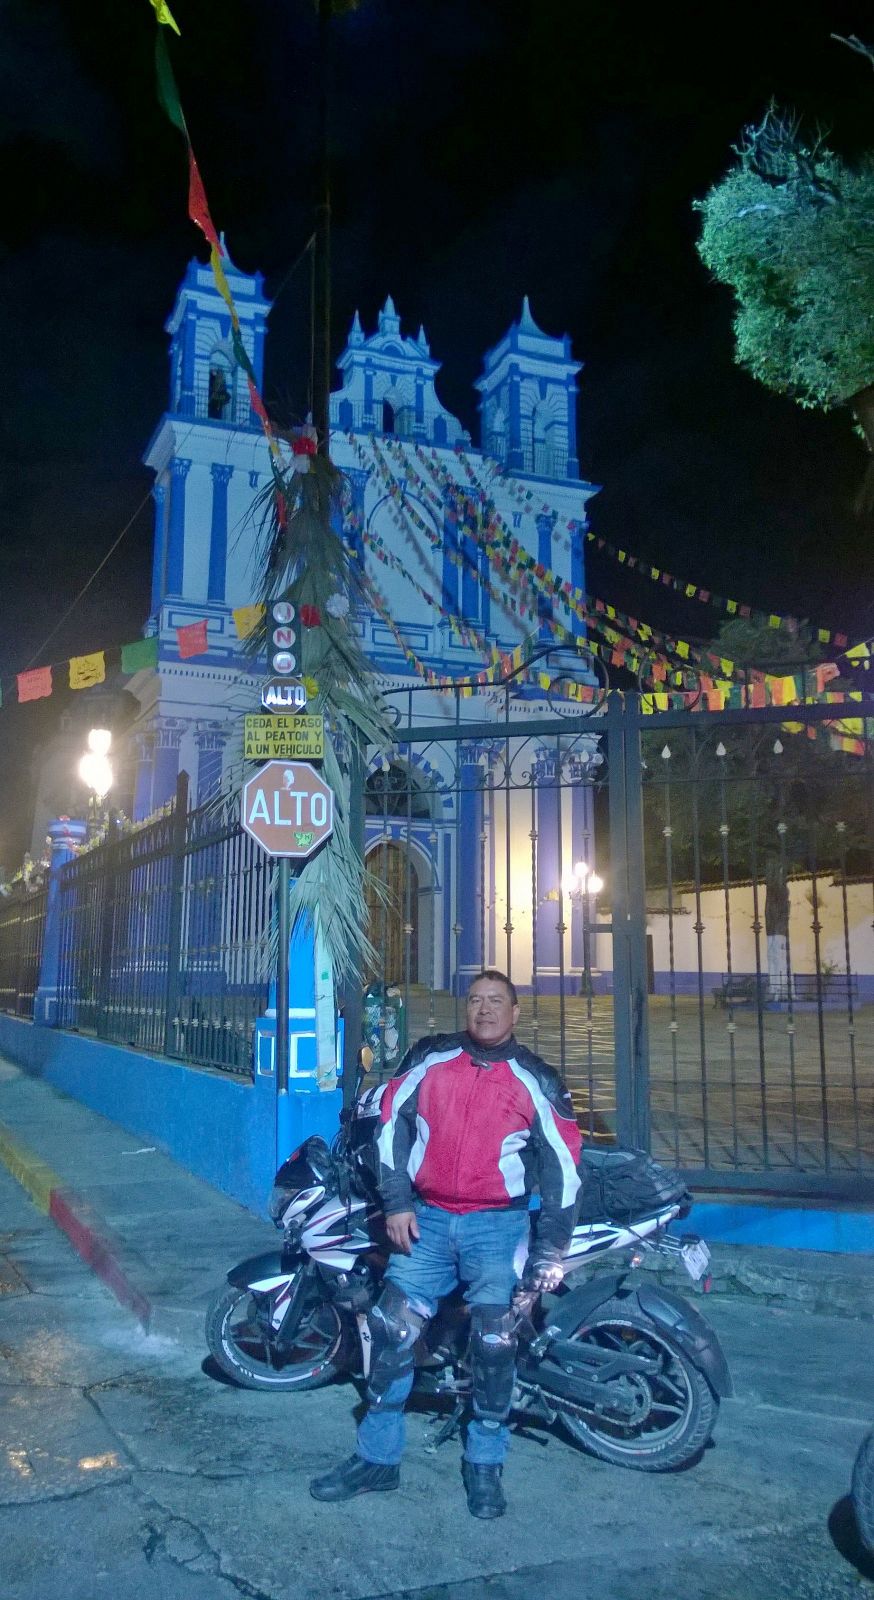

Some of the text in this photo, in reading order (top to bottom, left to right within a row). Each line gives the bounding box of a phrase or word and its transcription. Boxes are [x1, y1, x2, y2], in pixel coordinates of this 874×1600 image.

[266, 686, 305, 706] ALTO
[246, 717, 322, 728] CEDA EL PASO
[246, 731, 322, 741] AL PEATON Y
[246, 744, 322, 755] A UN VEHICULO
[249, 789, 327, 827] ALTO
